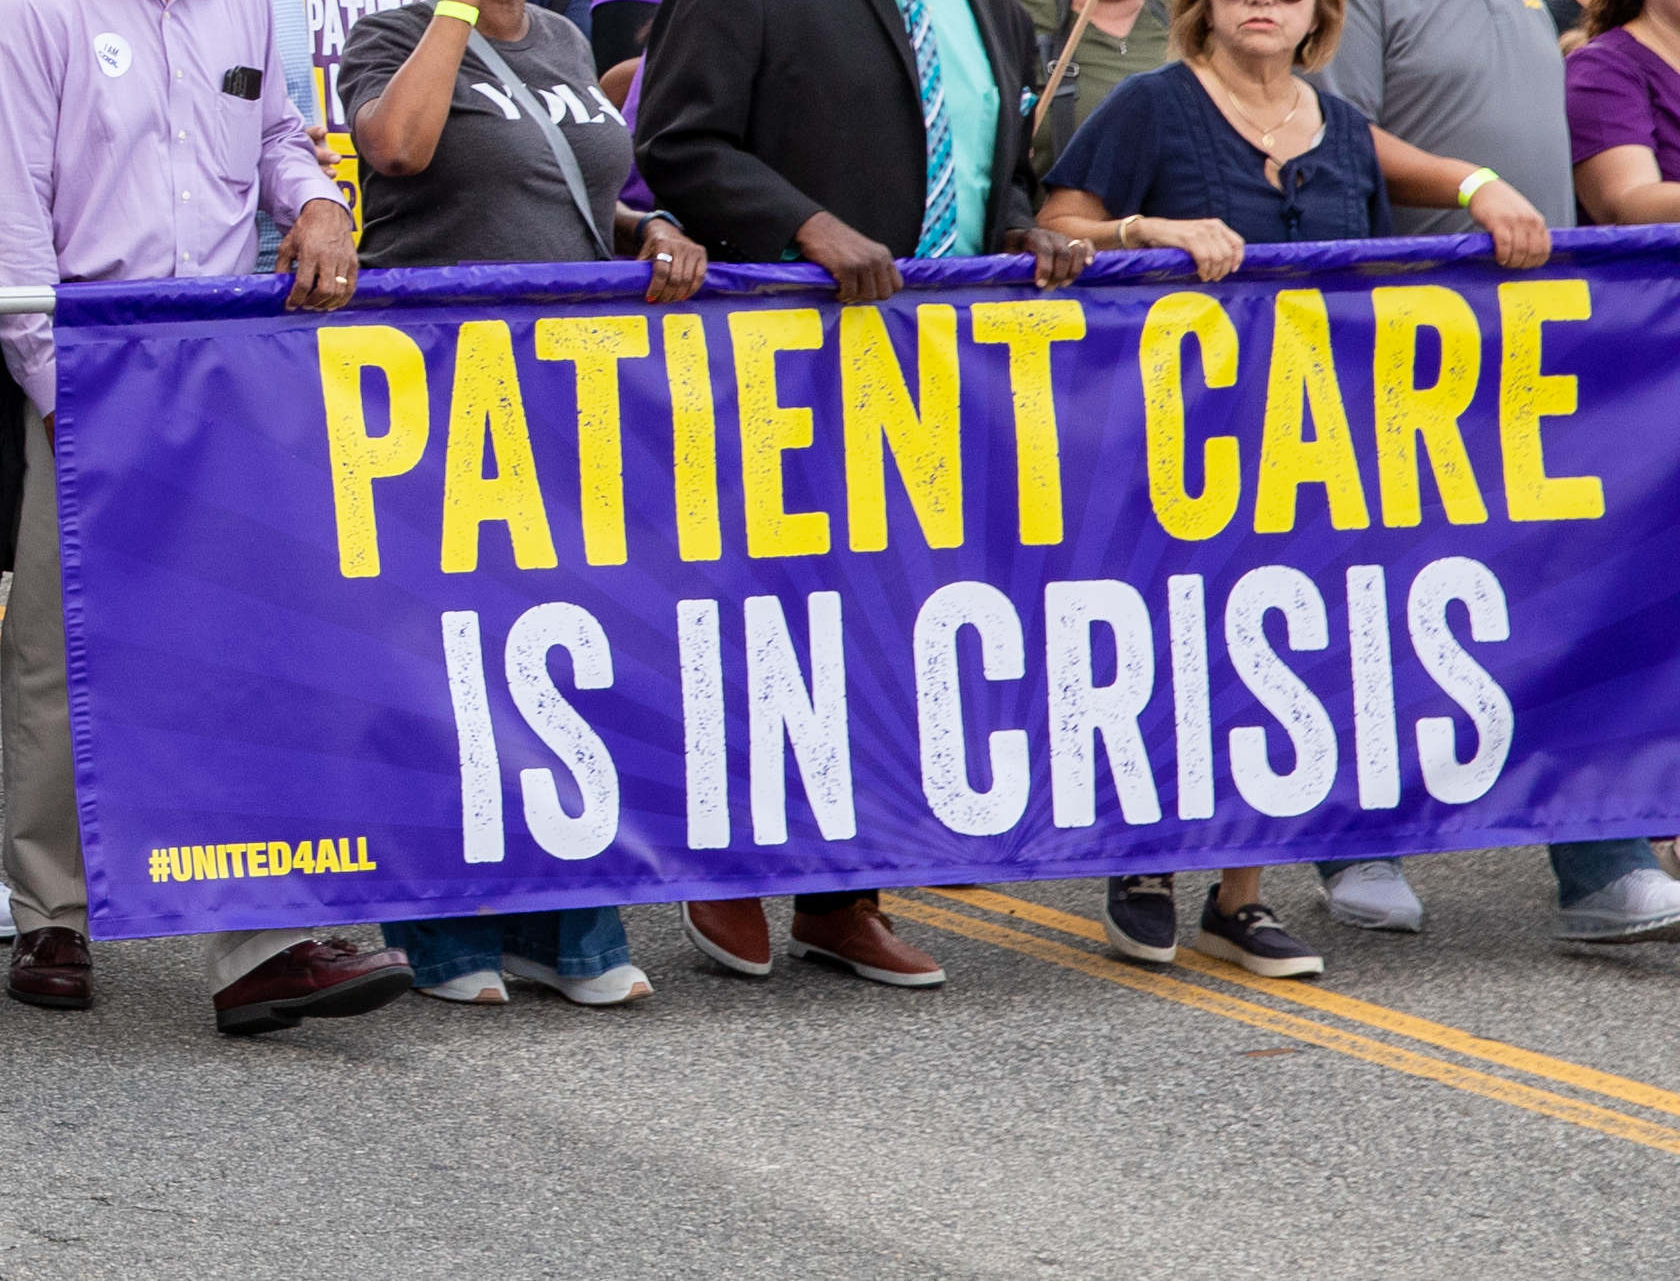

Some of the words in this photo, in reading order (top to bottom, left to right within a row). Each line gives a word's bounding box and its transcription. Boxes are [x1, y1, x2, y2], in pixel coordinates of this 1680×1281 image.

[317, 299, 1086, 578] PATIENT
[1139, 279, 1606, 542] CARE
[441, 602, 621, 865] IS
[677, 591, 858, 849] IN
[913, 556, 1514, 836] CRISIS
[148, 836, 377, 885] #UNITED4ALL
